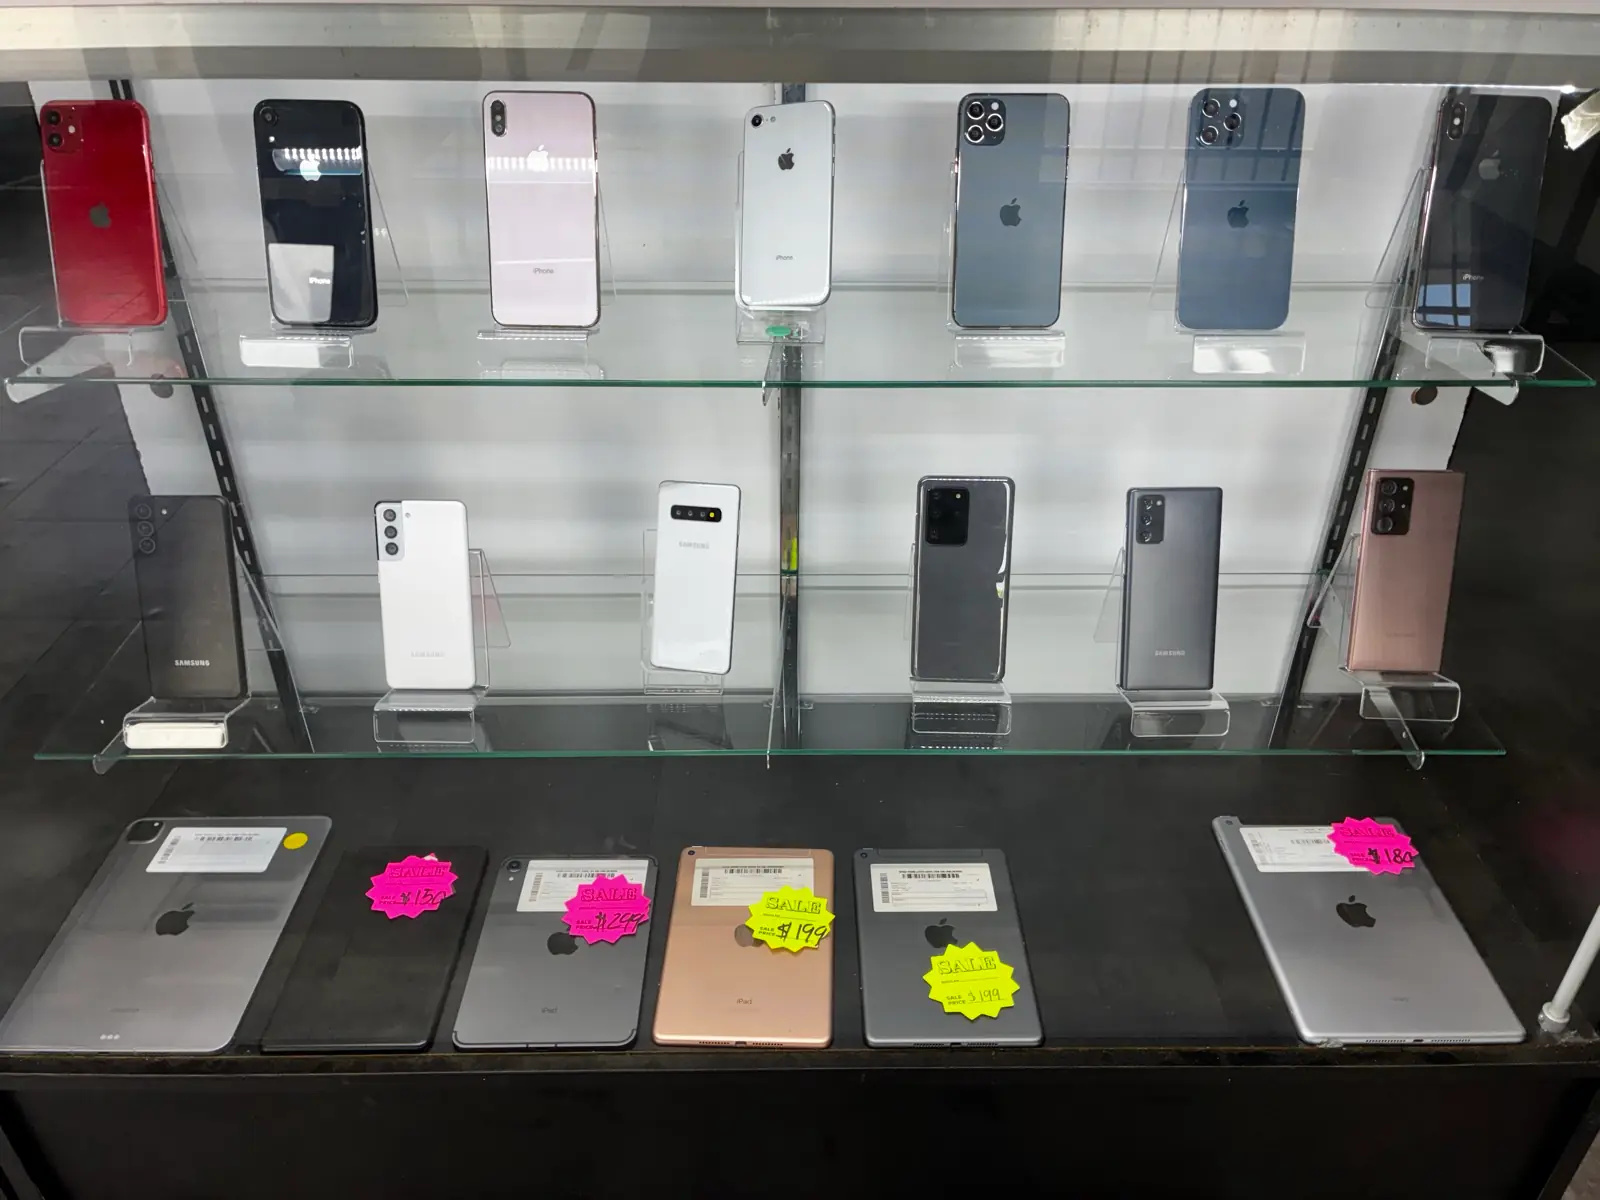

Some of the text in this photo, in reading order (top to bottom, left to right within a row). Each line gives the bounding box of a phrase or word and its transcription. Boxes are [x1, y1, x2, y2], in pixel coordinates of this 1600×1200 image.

[174, 658, 211, 668] SAMSUNG
[581, 887, 638, 902] SALE
[766, 896, 822, 915] SALE
[937, 956, 997, 975] SALE
